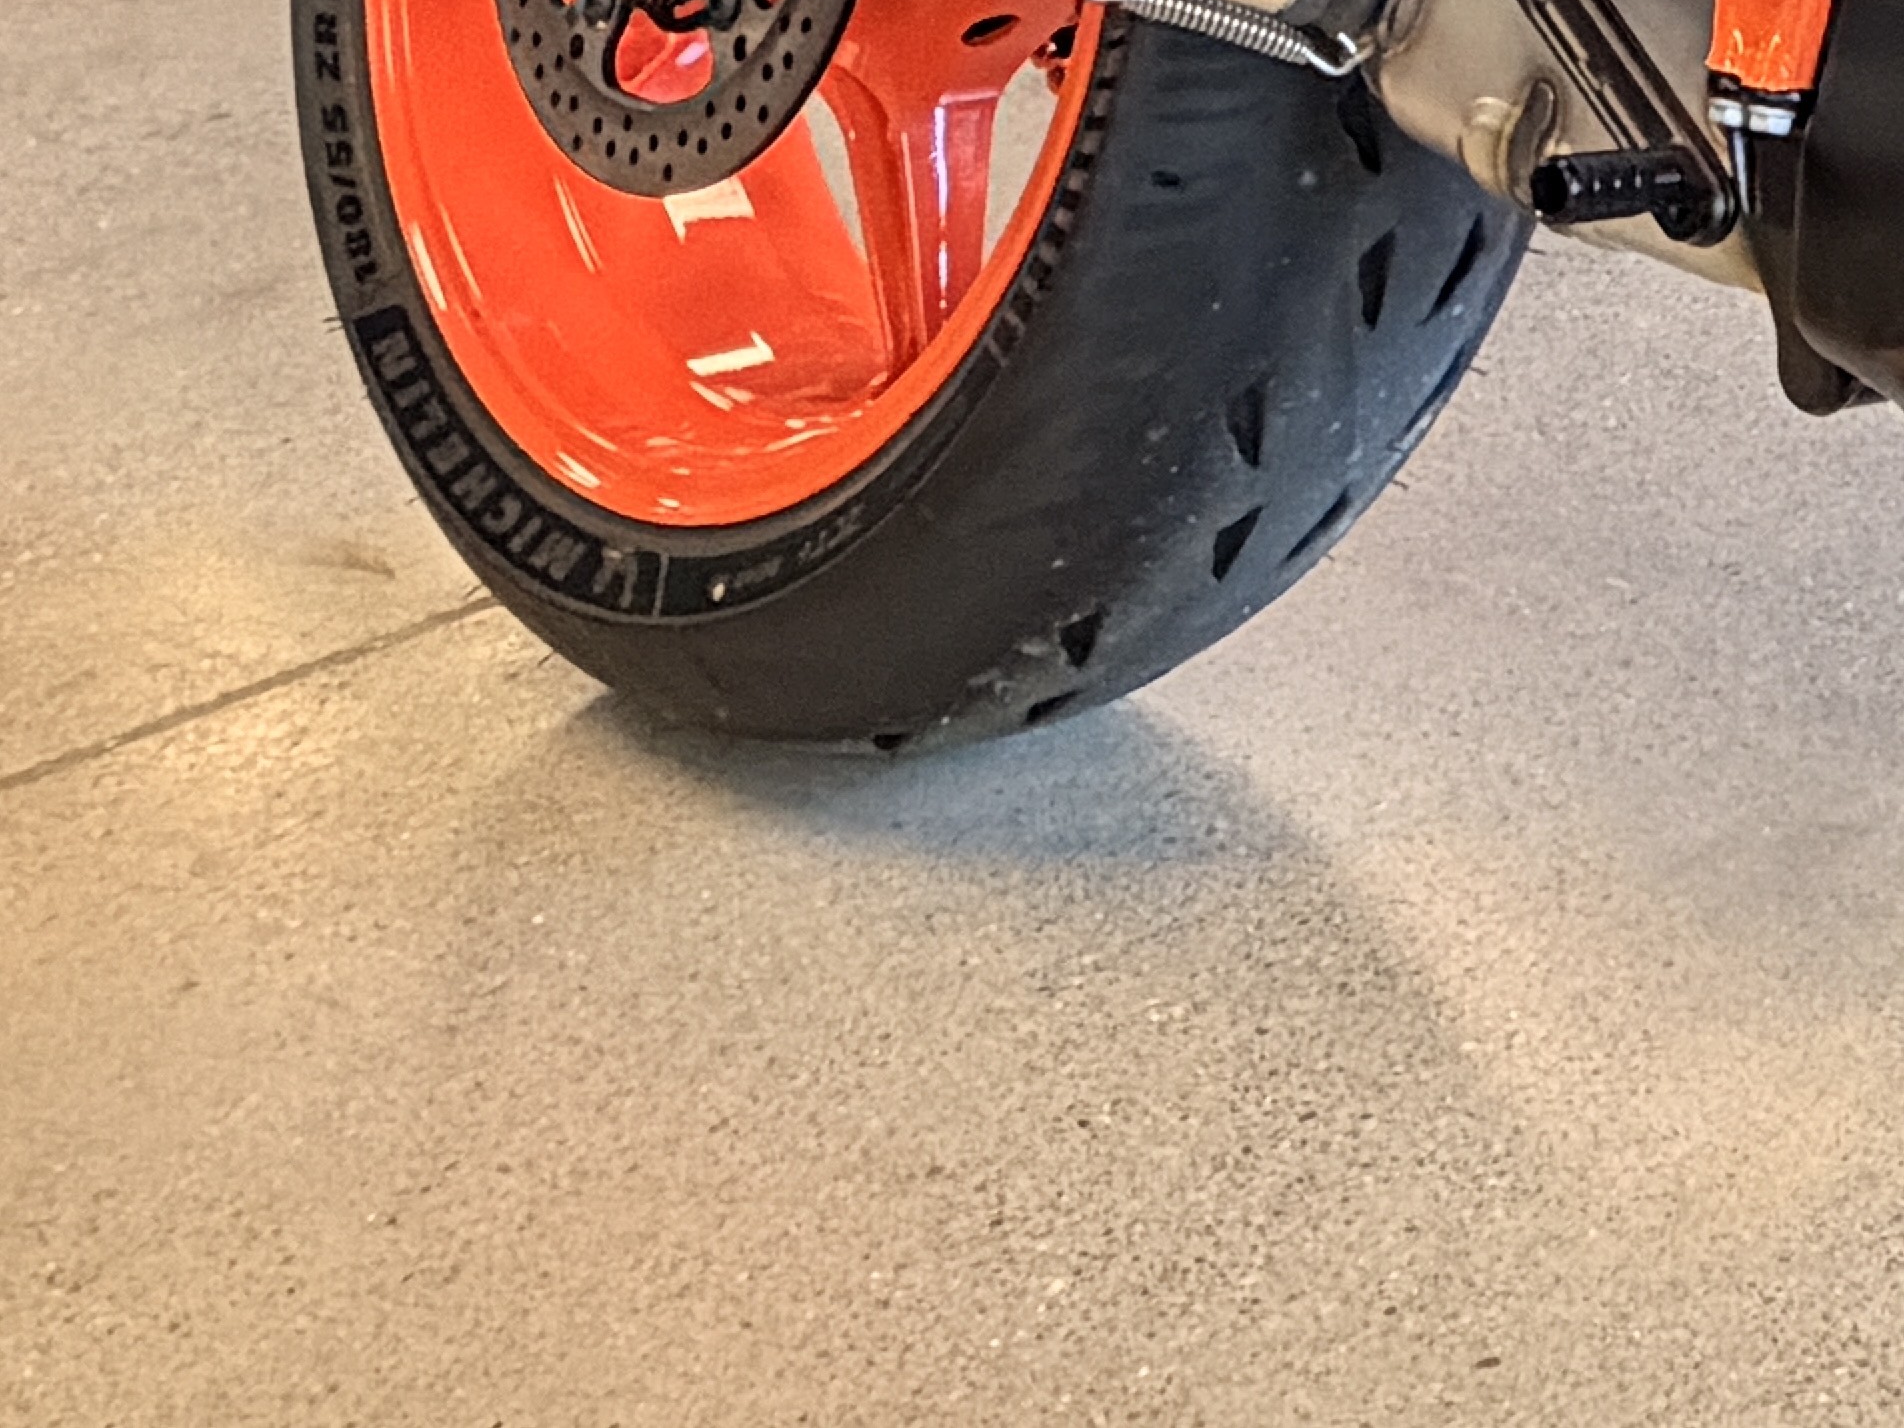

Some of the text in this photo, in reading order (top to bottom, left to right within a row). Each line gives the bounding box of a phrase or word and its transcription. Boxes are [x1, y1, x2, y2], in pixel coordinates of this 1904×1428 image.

[312, 12, 341, 83] ZR
[320, 105, 377, 285] 180/55
[371, 332, 588, 580] MICHELIN
